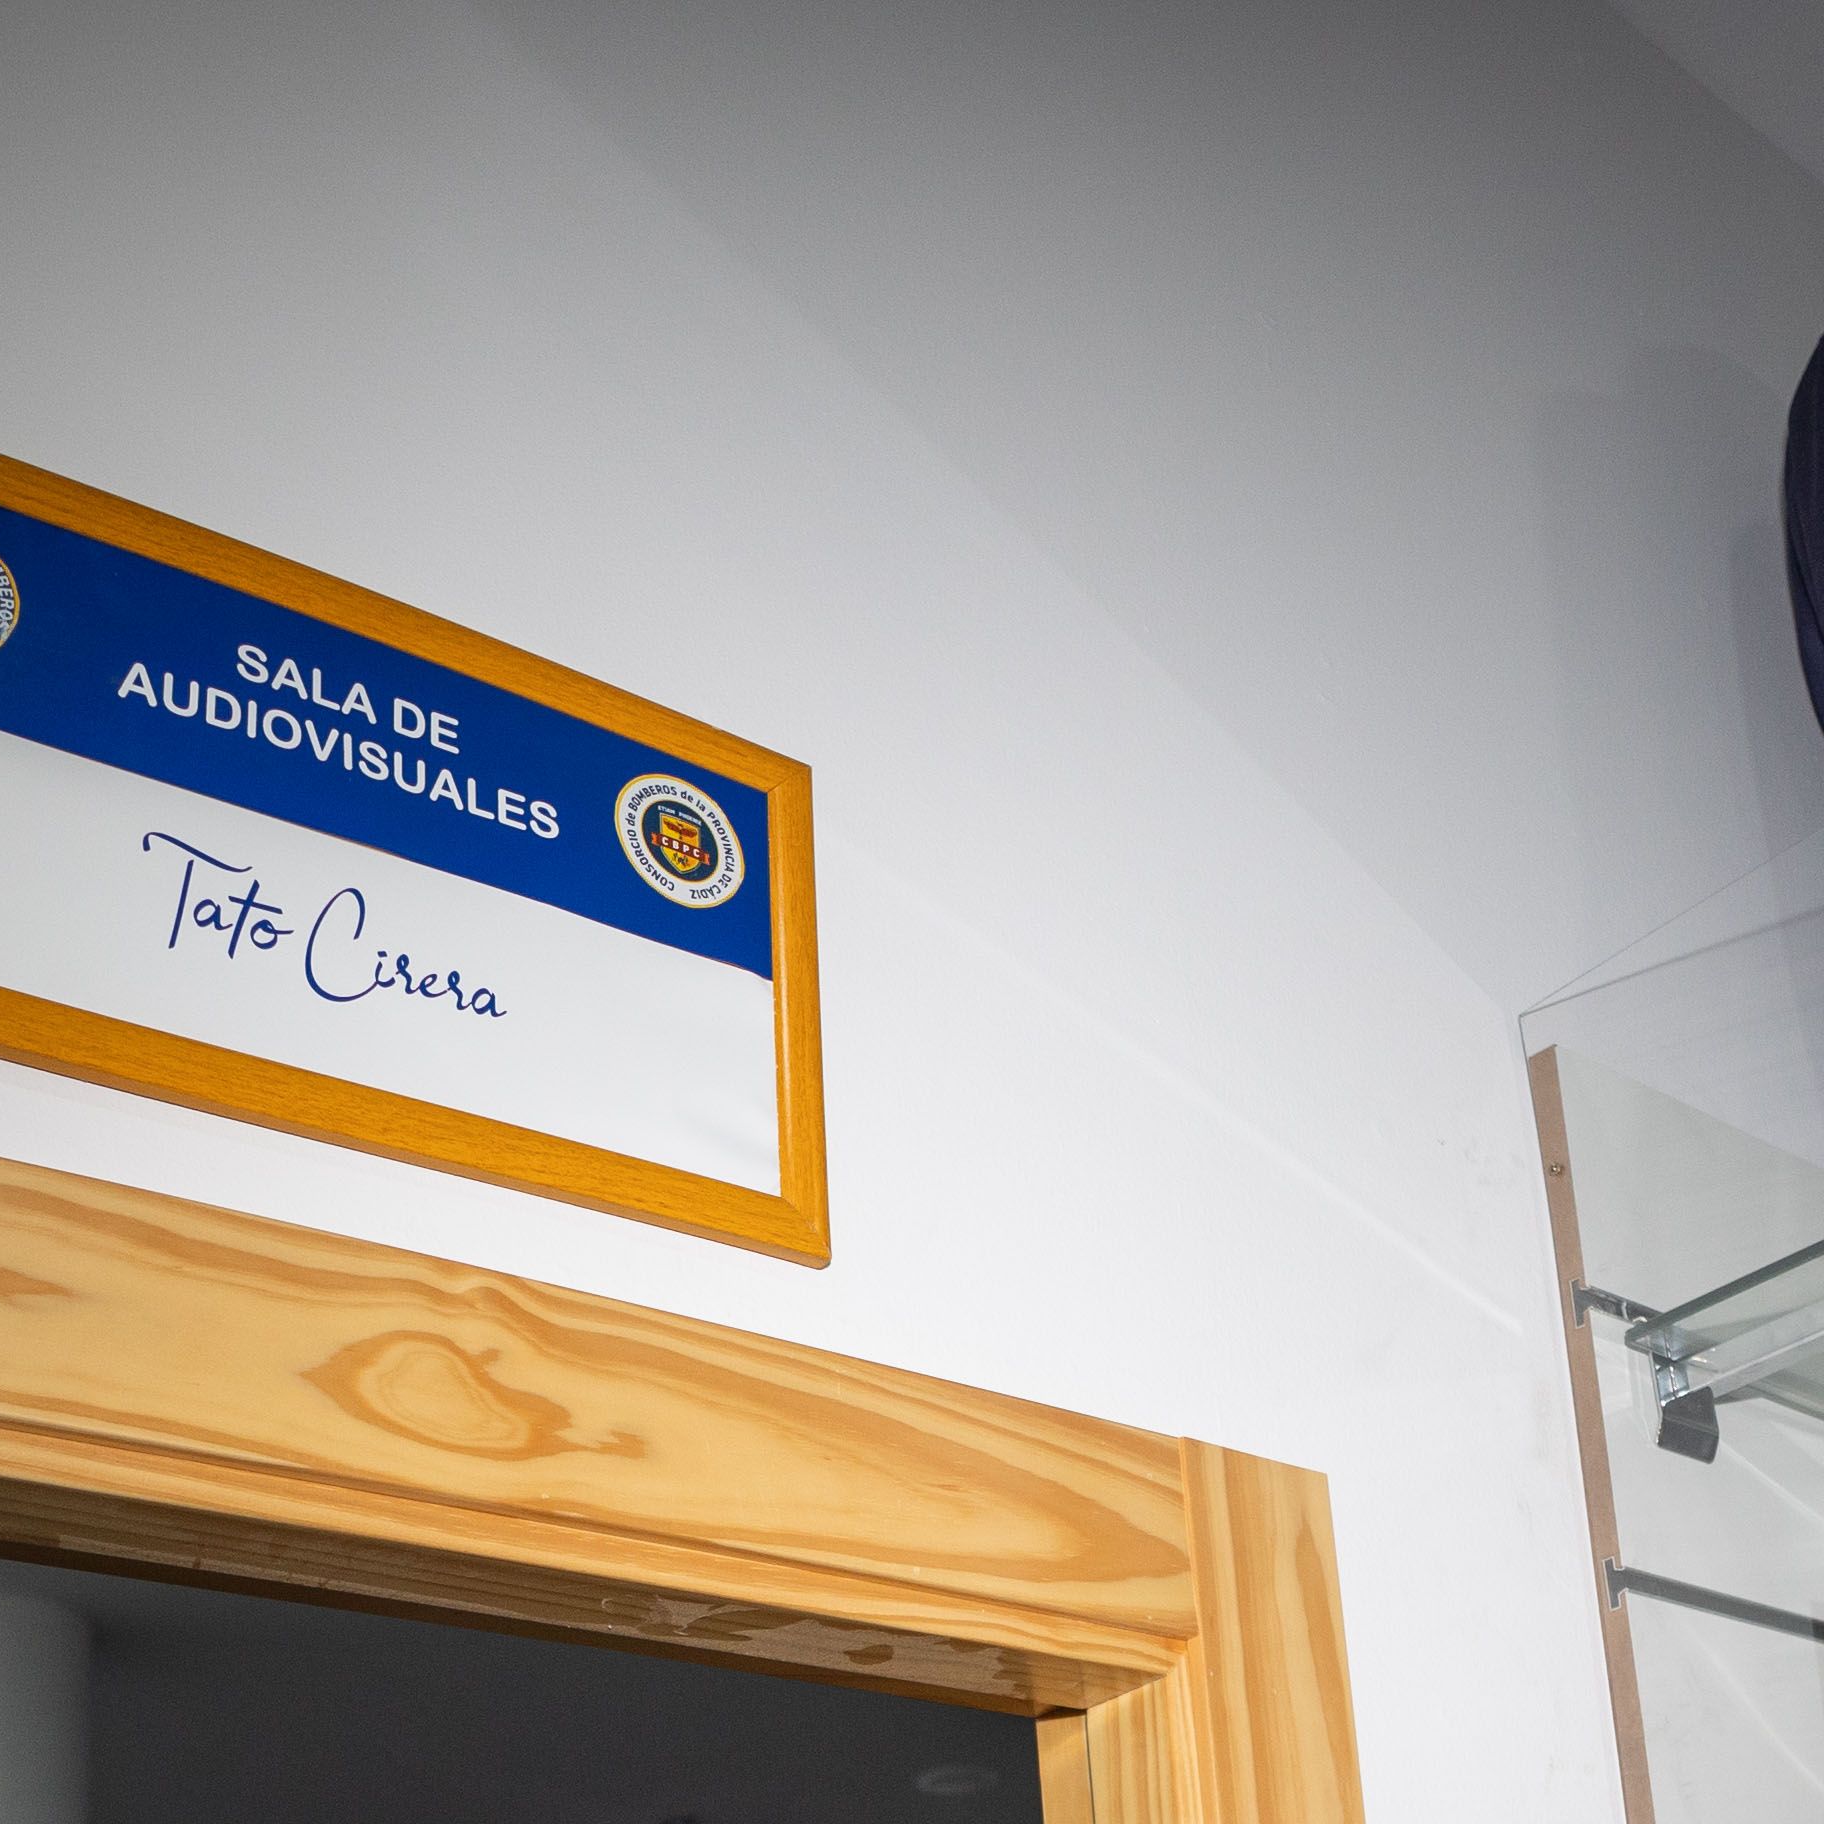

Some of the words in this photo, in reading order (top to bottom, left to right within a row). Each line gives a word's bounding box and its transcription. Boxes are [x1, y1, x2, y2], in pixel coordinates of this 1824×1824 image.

[236, 644, 377, 724] SALA
[393, 697, 460, 754] DE
[117, 662, 561, 839] AUDIOVISUALES
[628, 785, 677, 811] BOMBEROS
[680, 791, 694, 803] de
[696, 799, 706, 813] la
[625, 812, 636, 827] de
[627, 830, 675, 892] CONSORCIO
[707, 811, 735, 872] PROVINCIA
[718, 874, 732, 889] DE
[143, 832, 295, 959] Tato
[305, 888, 508, 1017] Cirera
